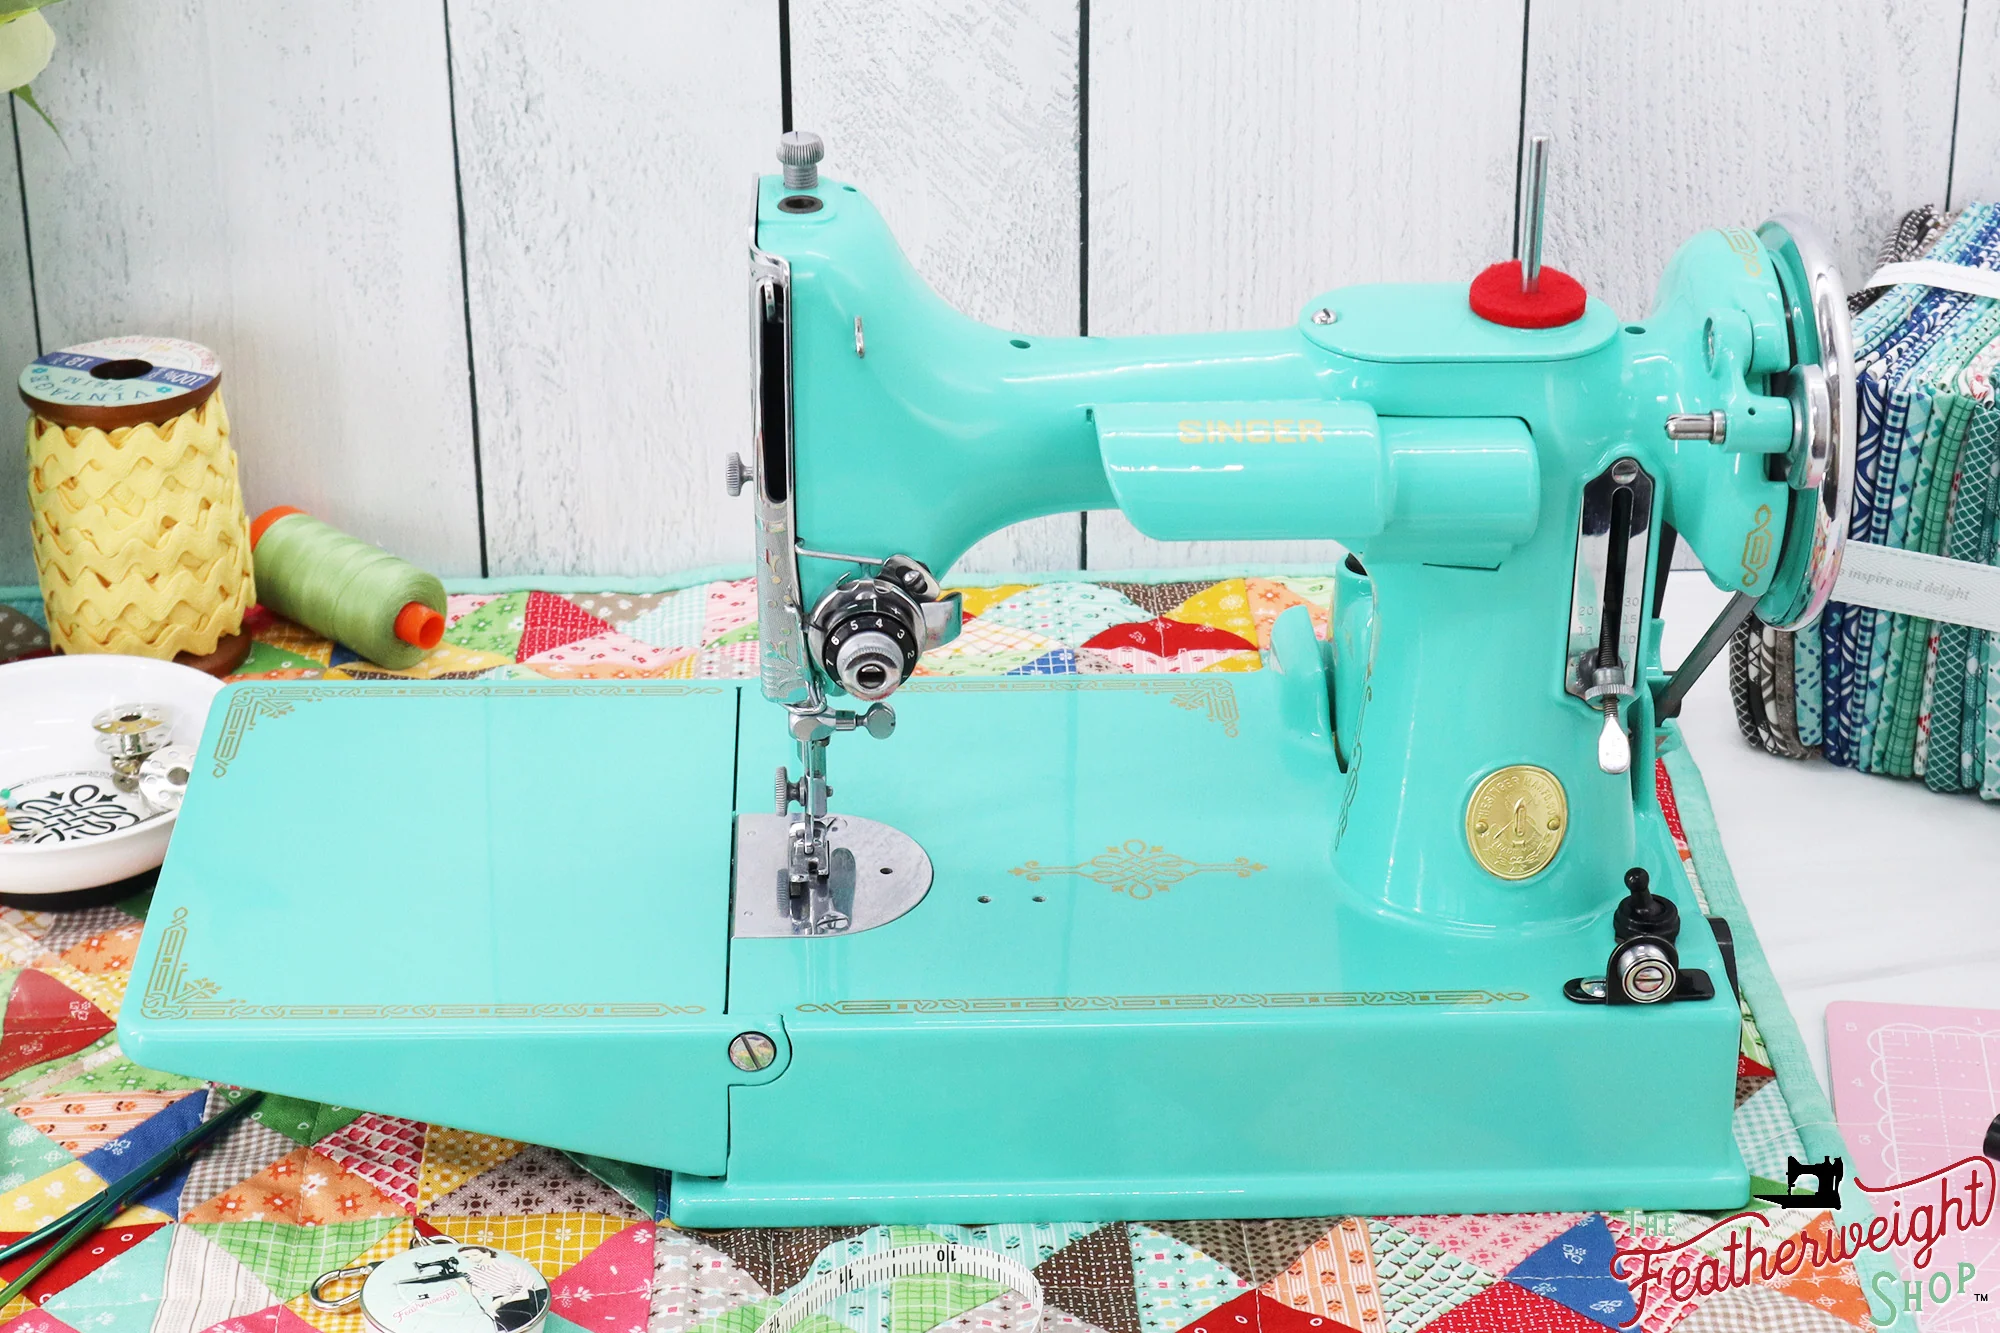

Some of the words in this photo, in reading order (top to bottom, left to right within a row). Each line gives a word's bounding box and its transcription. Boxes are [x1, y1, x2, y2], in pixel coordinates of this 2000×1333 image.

[62, 375, 124, 392] TRIM
[165, 370, 205, 387] 100%
[30, 375, 151, 402] VINTAGE
[1178, 419, 1325, 444] SINGER
[1849, 567, 1893, 585] inspire
[1895, 579, 1921, 592] and
[1923, 582, 1971, 601] delight
[1624, 596, 1640, 607] 30
[1579, 606, 1594, 616] 20
[875, 618, 884, 629] 4
[1622, 614, 1638, 625] 15
[850, 620, 859, 631] 5
[1578, 626, 1593, 636] 12
[897, 629, 905, 639] 3
[1622, 634, 1637, 645] 10
[830, 635, 840, 646] 6
[907, 651, 915, 659] 2
[825, 658, 834, 667] 7
[936, 1249, 957, 1262] 10
[839, 1268, 854, 1285] 11
